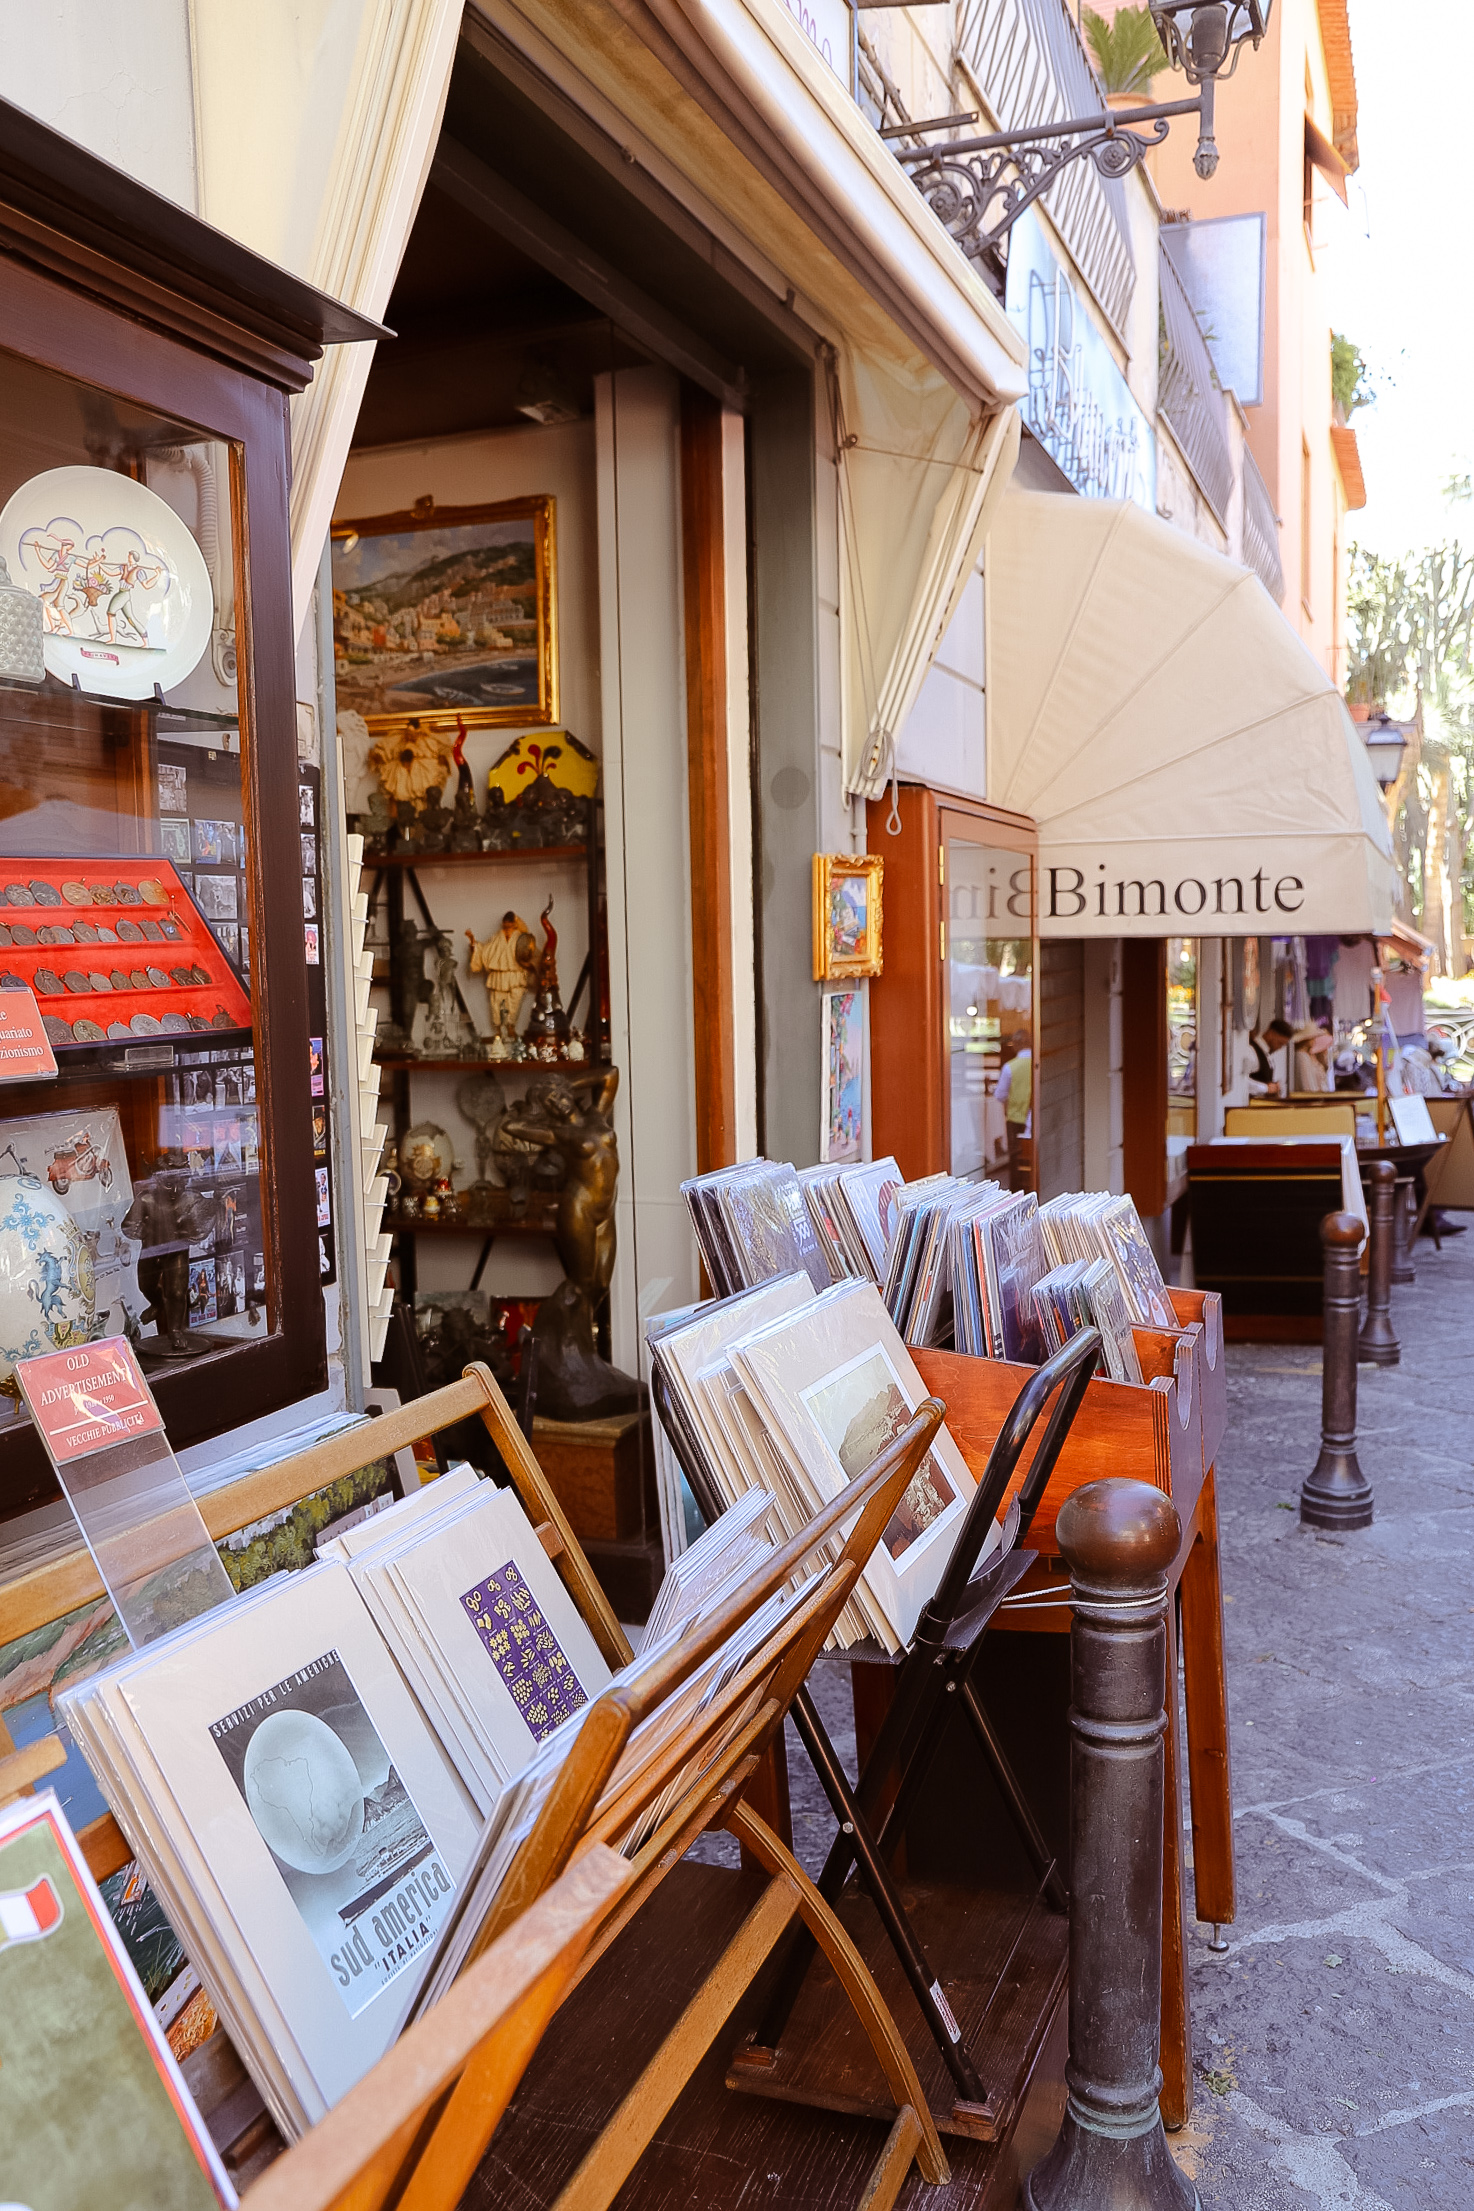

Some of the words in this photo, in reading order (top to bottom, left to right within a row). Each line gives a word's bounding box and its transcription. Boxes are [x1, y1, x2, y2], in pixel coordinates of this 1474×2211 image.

[1044, 863, 1304, 919] Bimonte
[0, 1026, 33, 1041] uariato
[66, 1353, 90, 1371] OLD
[66, 1426, 102, 1448] VECCHIE
[212, 1704, 255, 1738] SERVIZI
[257, 1690, 277, 1710] PER
[279, 1680, 293, 1696] LE
[294, 1650, 340, 1686] AMERICHE
[331, 1924, 375, 1987] sud
[372, 1862, 451, 1948] america
